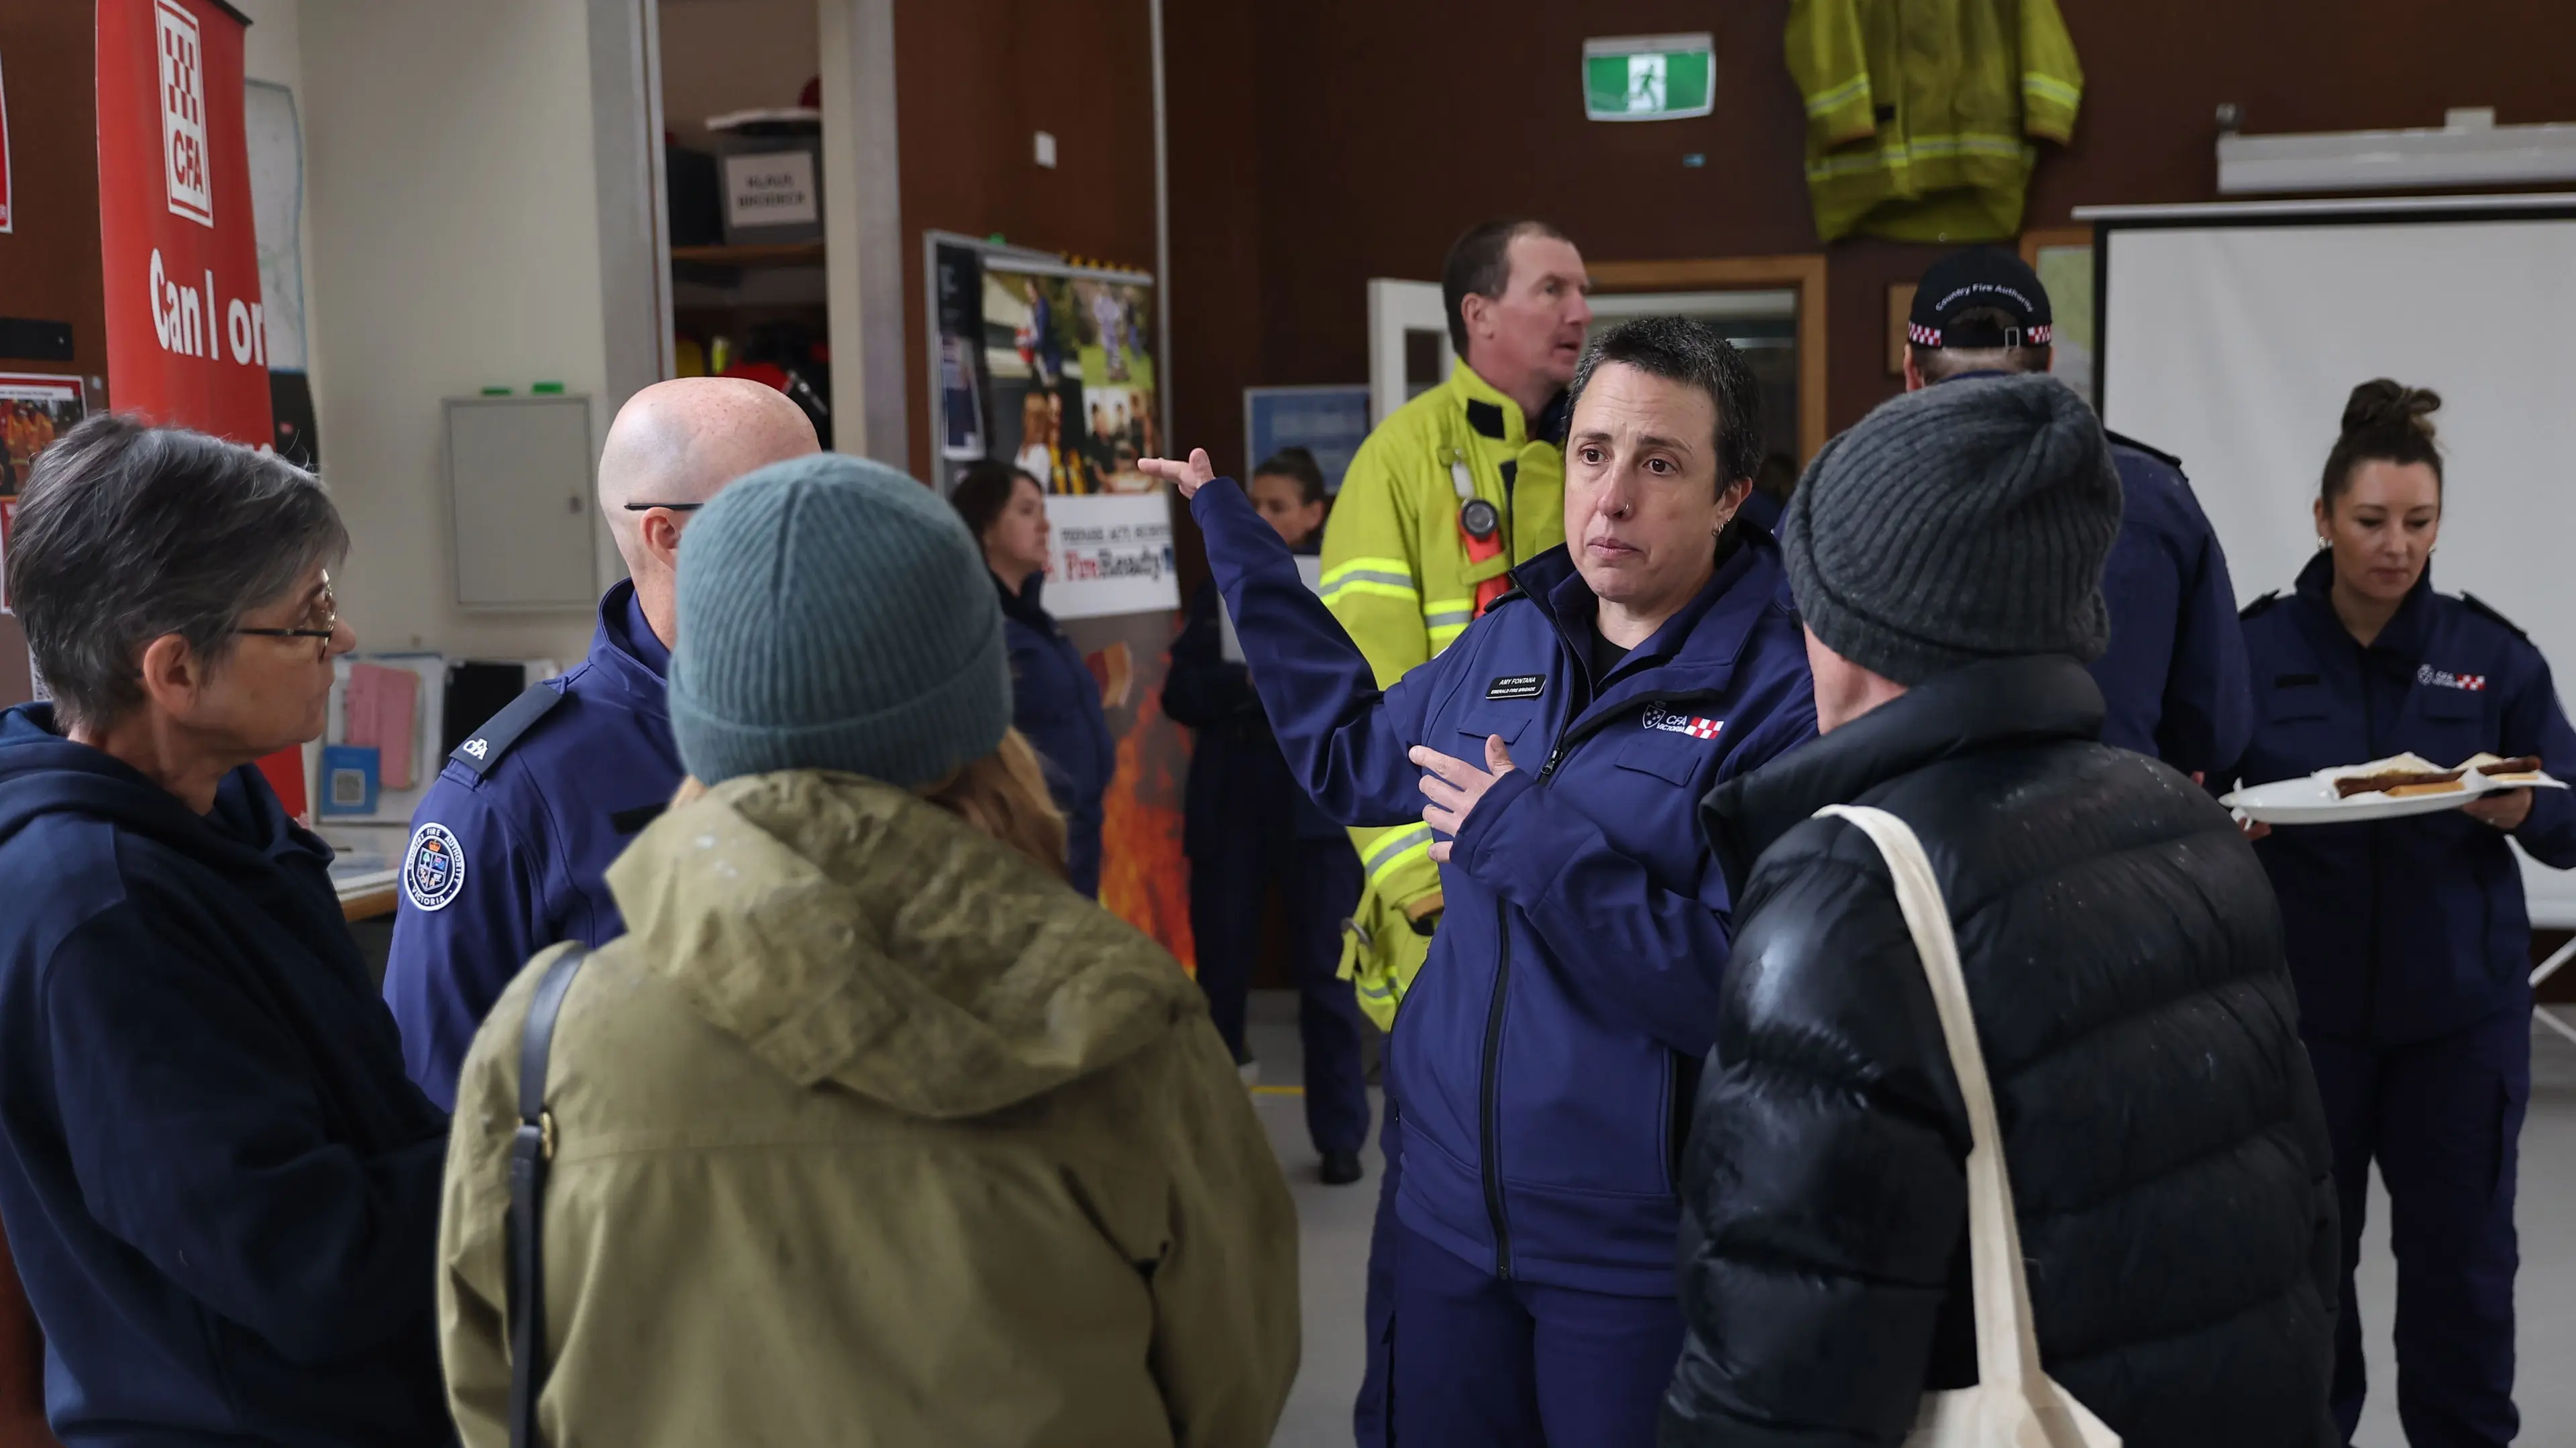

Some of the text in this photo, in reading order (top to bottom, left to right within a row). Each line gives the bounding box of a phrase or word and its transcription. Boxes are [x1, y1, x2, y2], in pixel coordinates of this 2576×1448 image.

[173, 129, 204, 195] CFA
[149, 247, 265, 366] Can I or
[1935, 283, 2034, 313] Country Fire Authority
[1511, 677, 1536, 685] FONTANA
[1656, 722, 1685, 733] VICTORIA
[1666, 715, 1688, 726] CFA
[408, 828, 462, 885] COUNTRY FIRE AUTHORITY
[412, 885, 445, 906] VICTORIA
